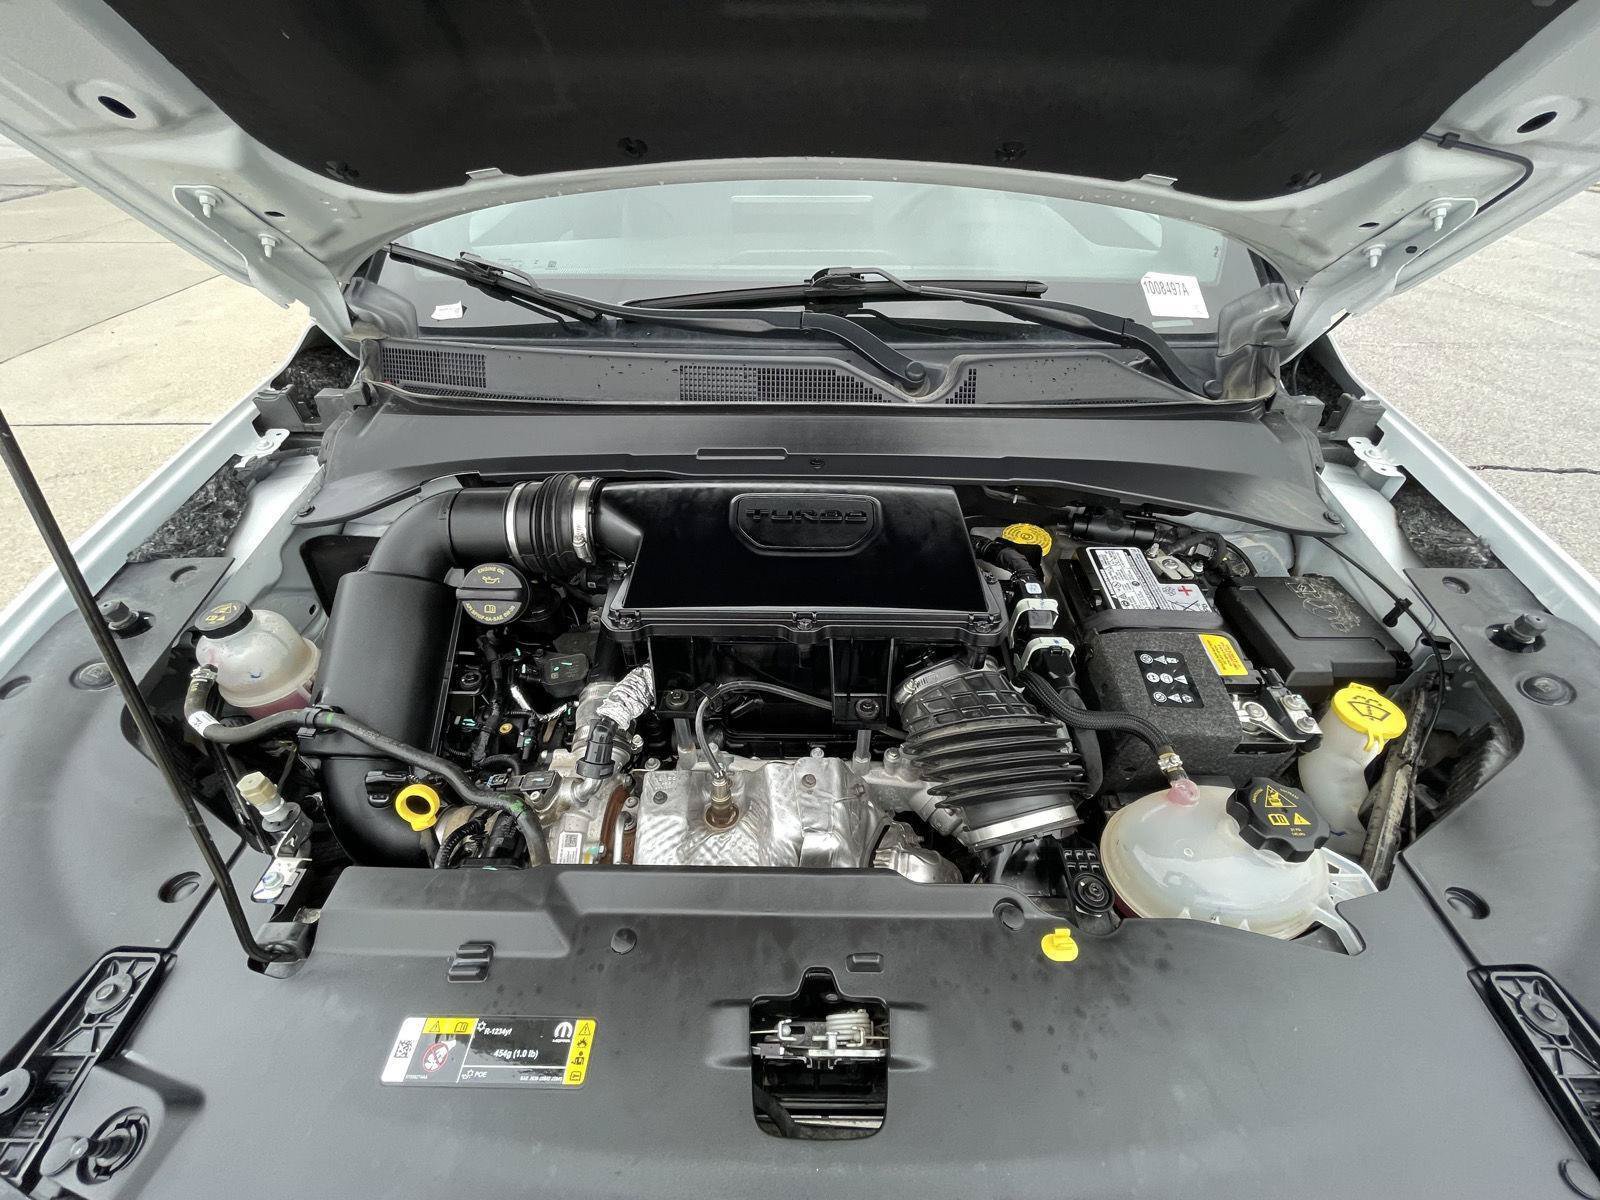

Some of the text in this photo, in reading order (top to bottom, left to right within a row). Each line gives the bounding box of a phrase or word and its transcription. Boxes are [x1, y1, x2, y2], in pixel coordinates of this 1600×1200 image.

[1143, 280, 1190, 296] 1008497A
[745, 508, 868, 523] TURBO
[484, 1027, 513, 1037] R-1234yf
[493, 1049, 539, 1060] 454g (1.0 lb)
